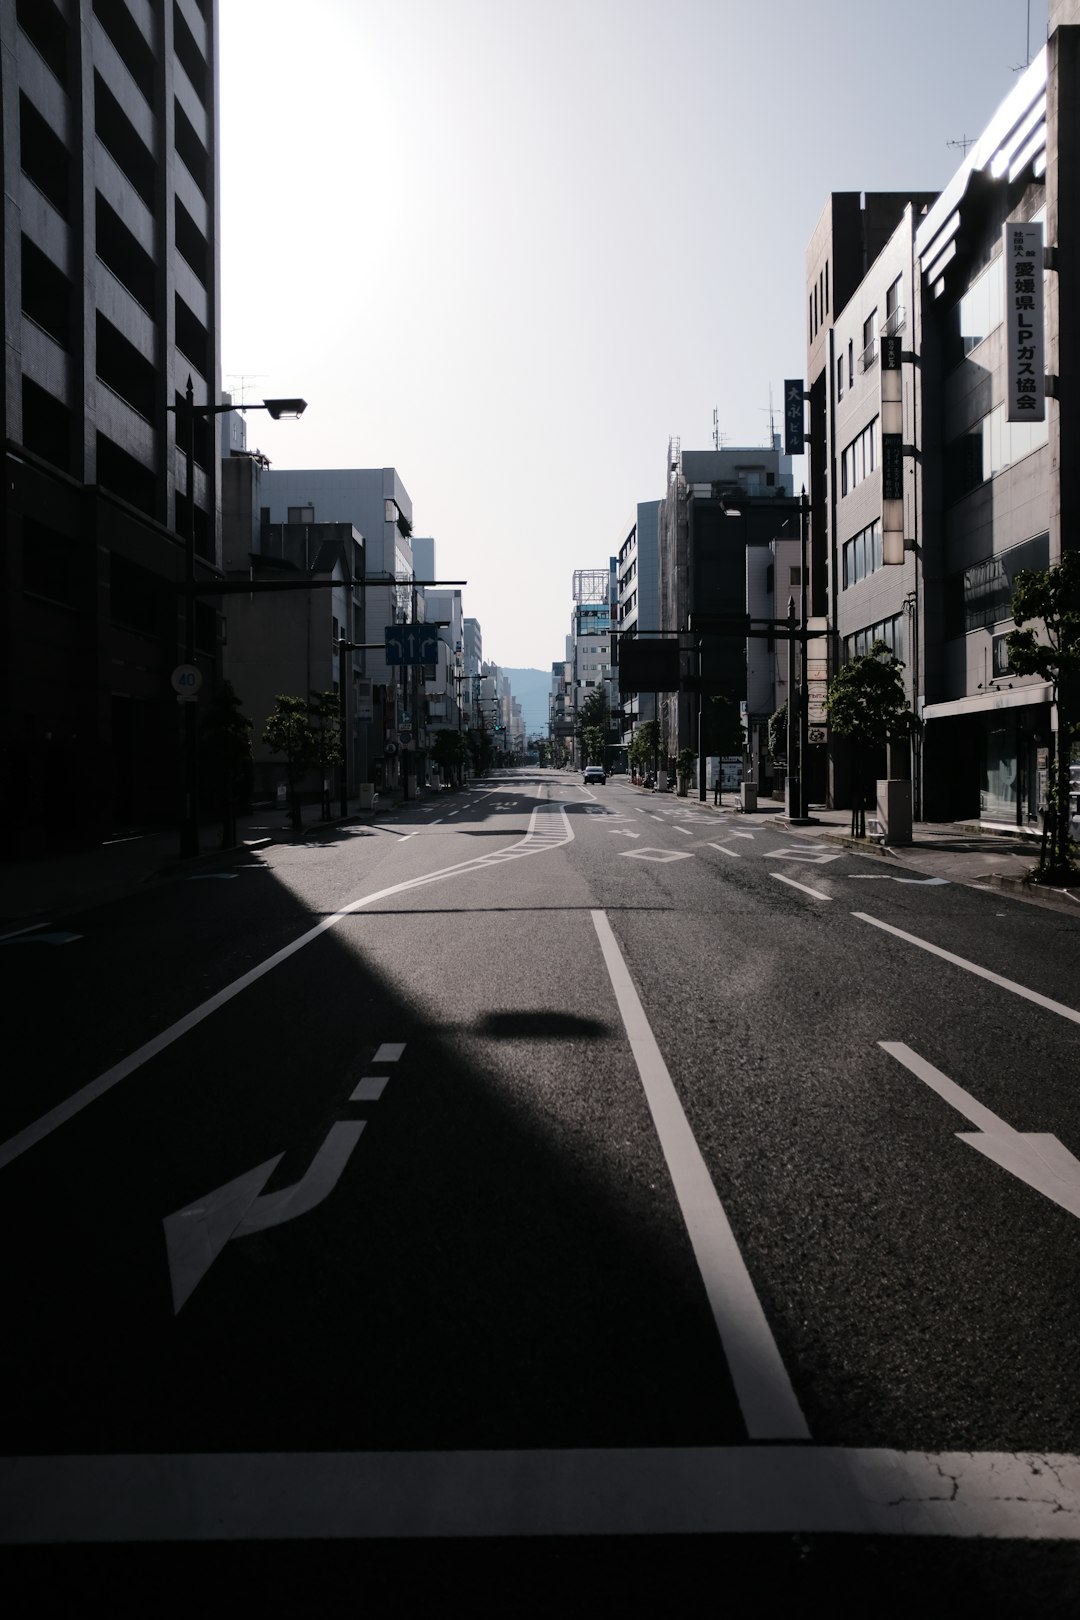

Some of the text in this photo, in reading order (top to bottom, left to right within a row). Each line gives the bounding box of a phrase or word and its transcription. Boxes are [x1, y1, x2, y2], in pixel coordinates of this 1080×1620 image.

[1013, 231, 1024, 257] 社団法人
[1025, 233, 1036, 257] 一般
[1014, 261, 1036, 410] 愛媛県LPガス協会
[787, 386, 802, 445] 大永ビル
[178, 672, 195, 687] 40
